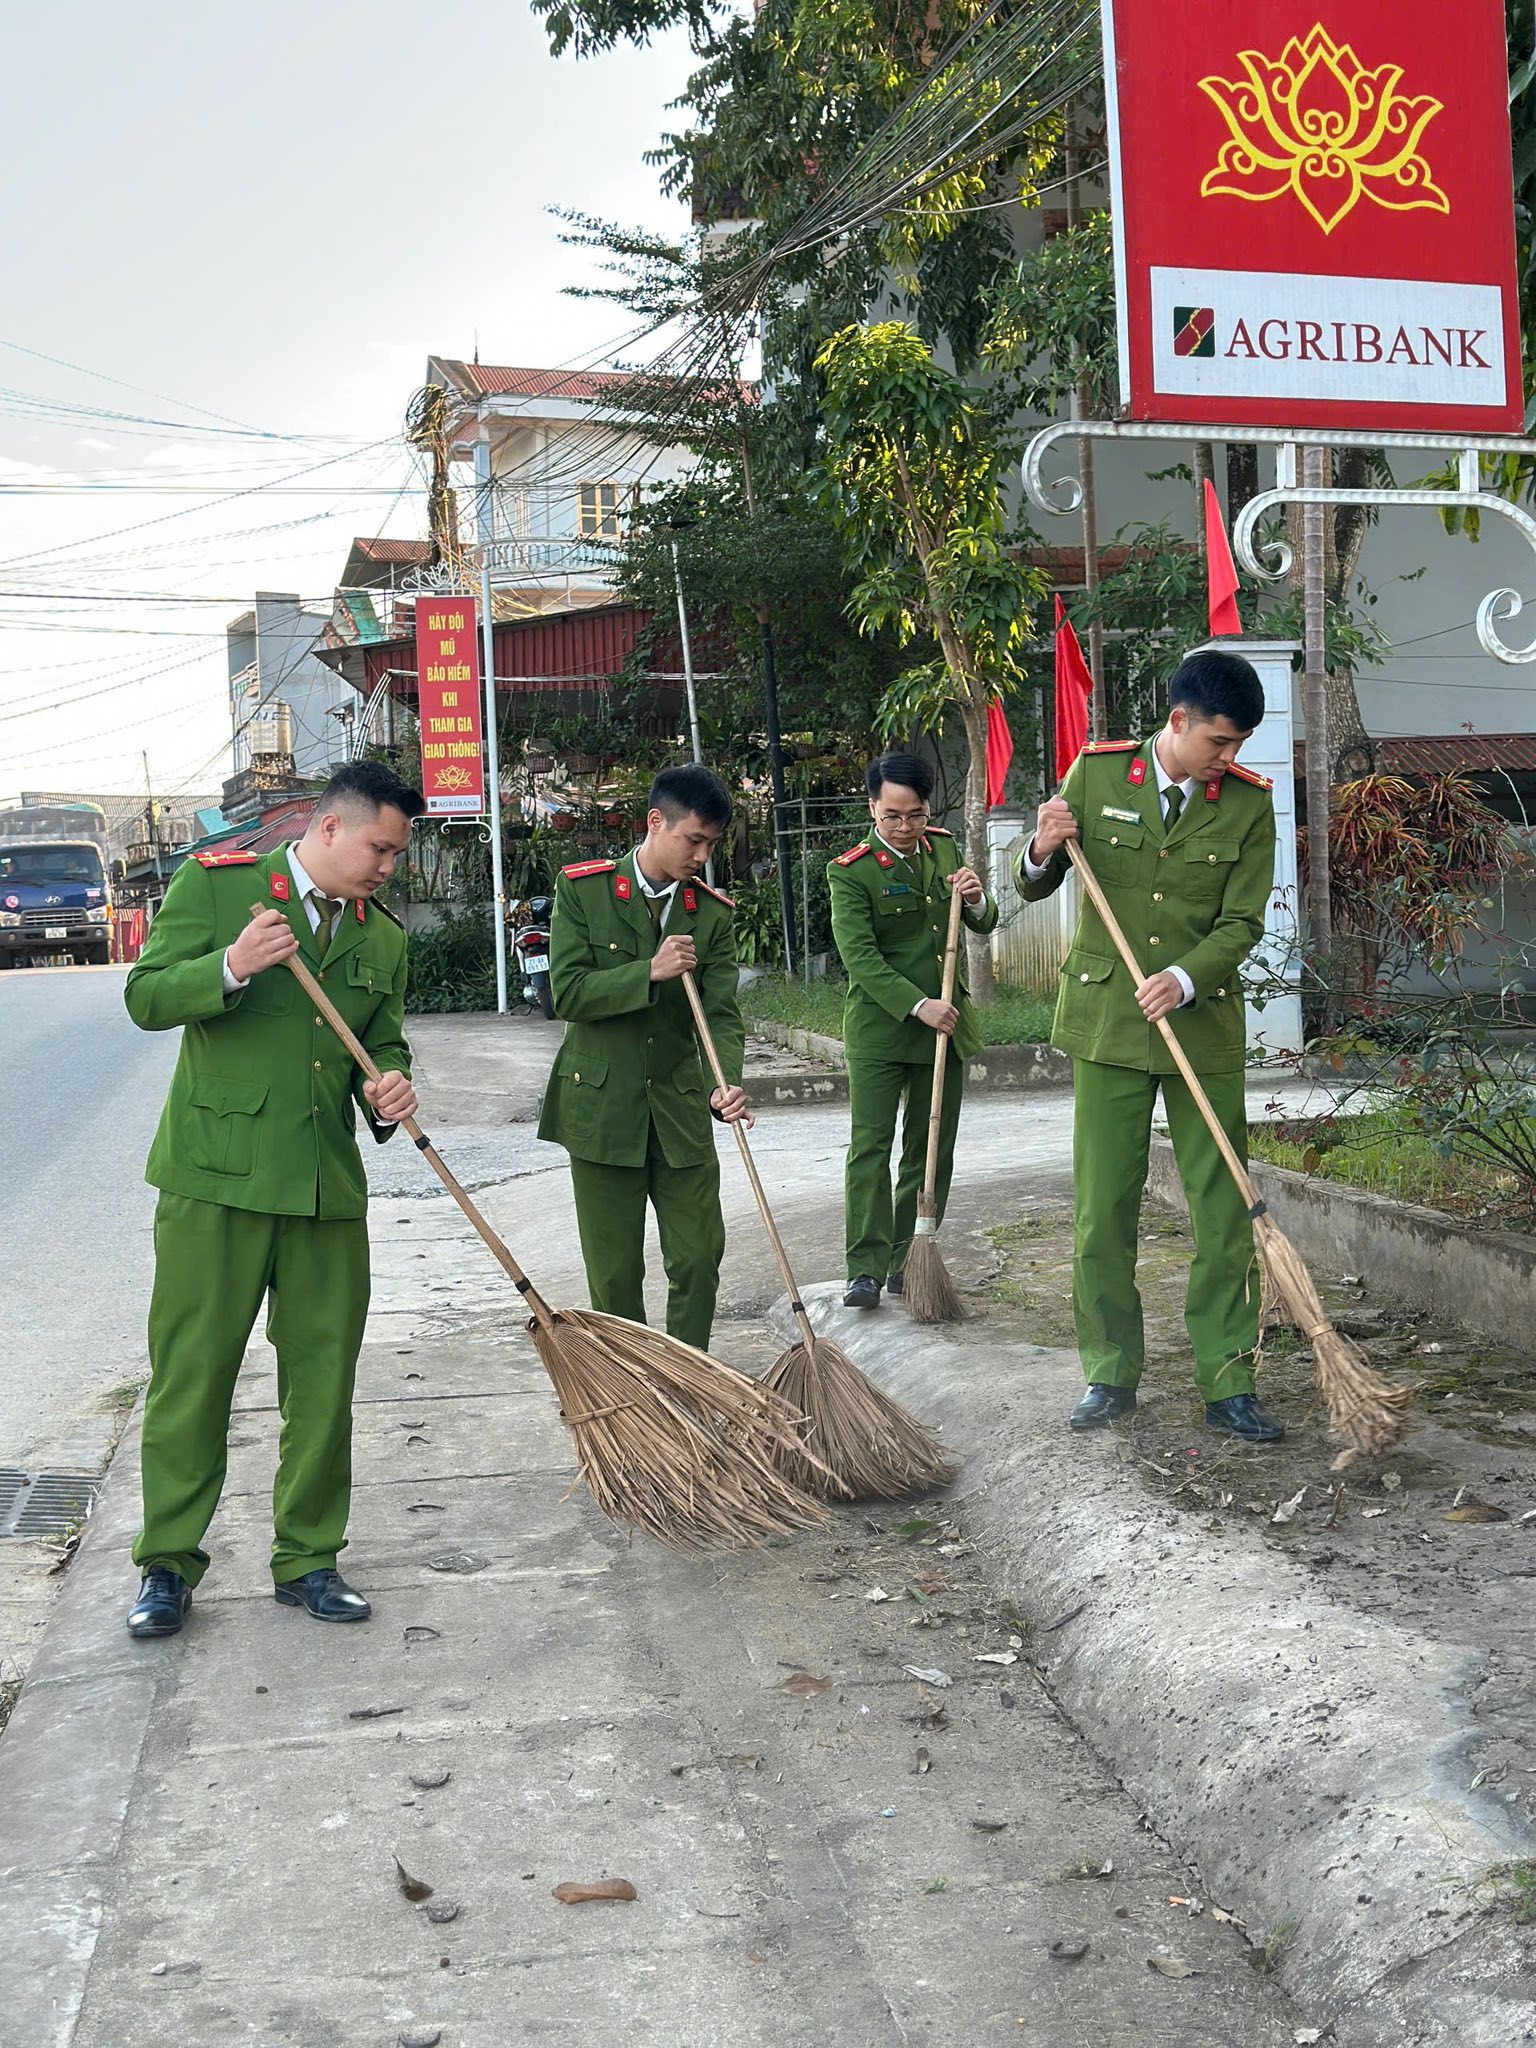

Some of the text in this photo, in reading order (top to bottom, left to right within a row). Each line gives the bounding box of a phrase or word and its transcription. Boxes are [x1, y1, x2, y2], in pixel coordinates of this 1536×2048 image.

[1224, 317, 1493, 369] AGRIBANK
[428, 611, 465, 633] HÃY ĐỘI
[440, 637, 456, 656] MŨ
[426, 659, 471, 682] BẢO HIỂM
[441, 691, 458, 707] KHI
[429, 717, 473, 733] THAM GIA
[424, 740, 480, 759] GIAO THÔNG!
[438, 800, 479, 808] AGRIBANK
